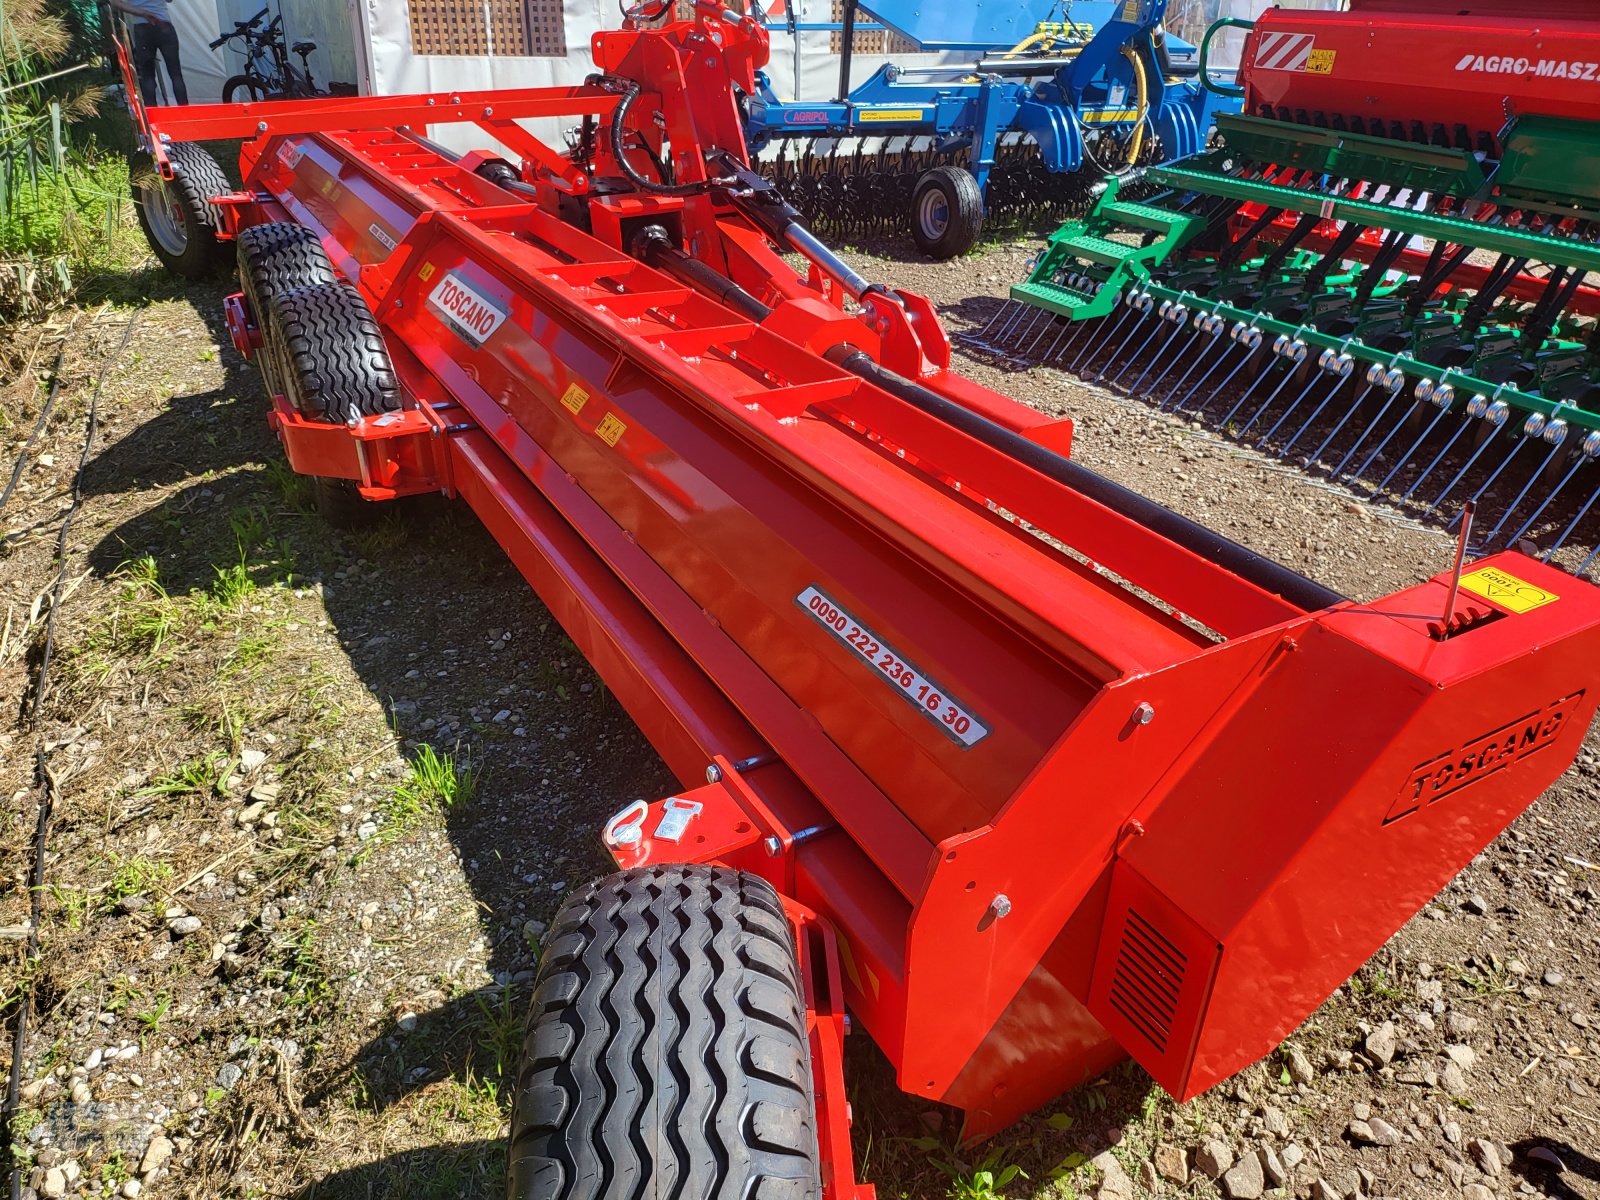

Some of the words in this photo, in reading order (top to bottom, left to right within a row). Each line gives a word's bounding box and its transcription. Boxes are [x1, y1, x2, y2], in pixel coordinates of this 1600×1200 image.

[793, 111, 829, 121] AGRIPOL
[438, 279, 496, 336] TOSCANO
[1481, 573, 1512, 587] 1000
[809, 595, 847, 632] 0090
[846, 627, 880, 660] 222
[878, 654, 915, 688] 236
[917, 685, 942, 711] 16
[942, 706, 971, 735] 30
[1412, 712, 1563, 802] TOSCANO
